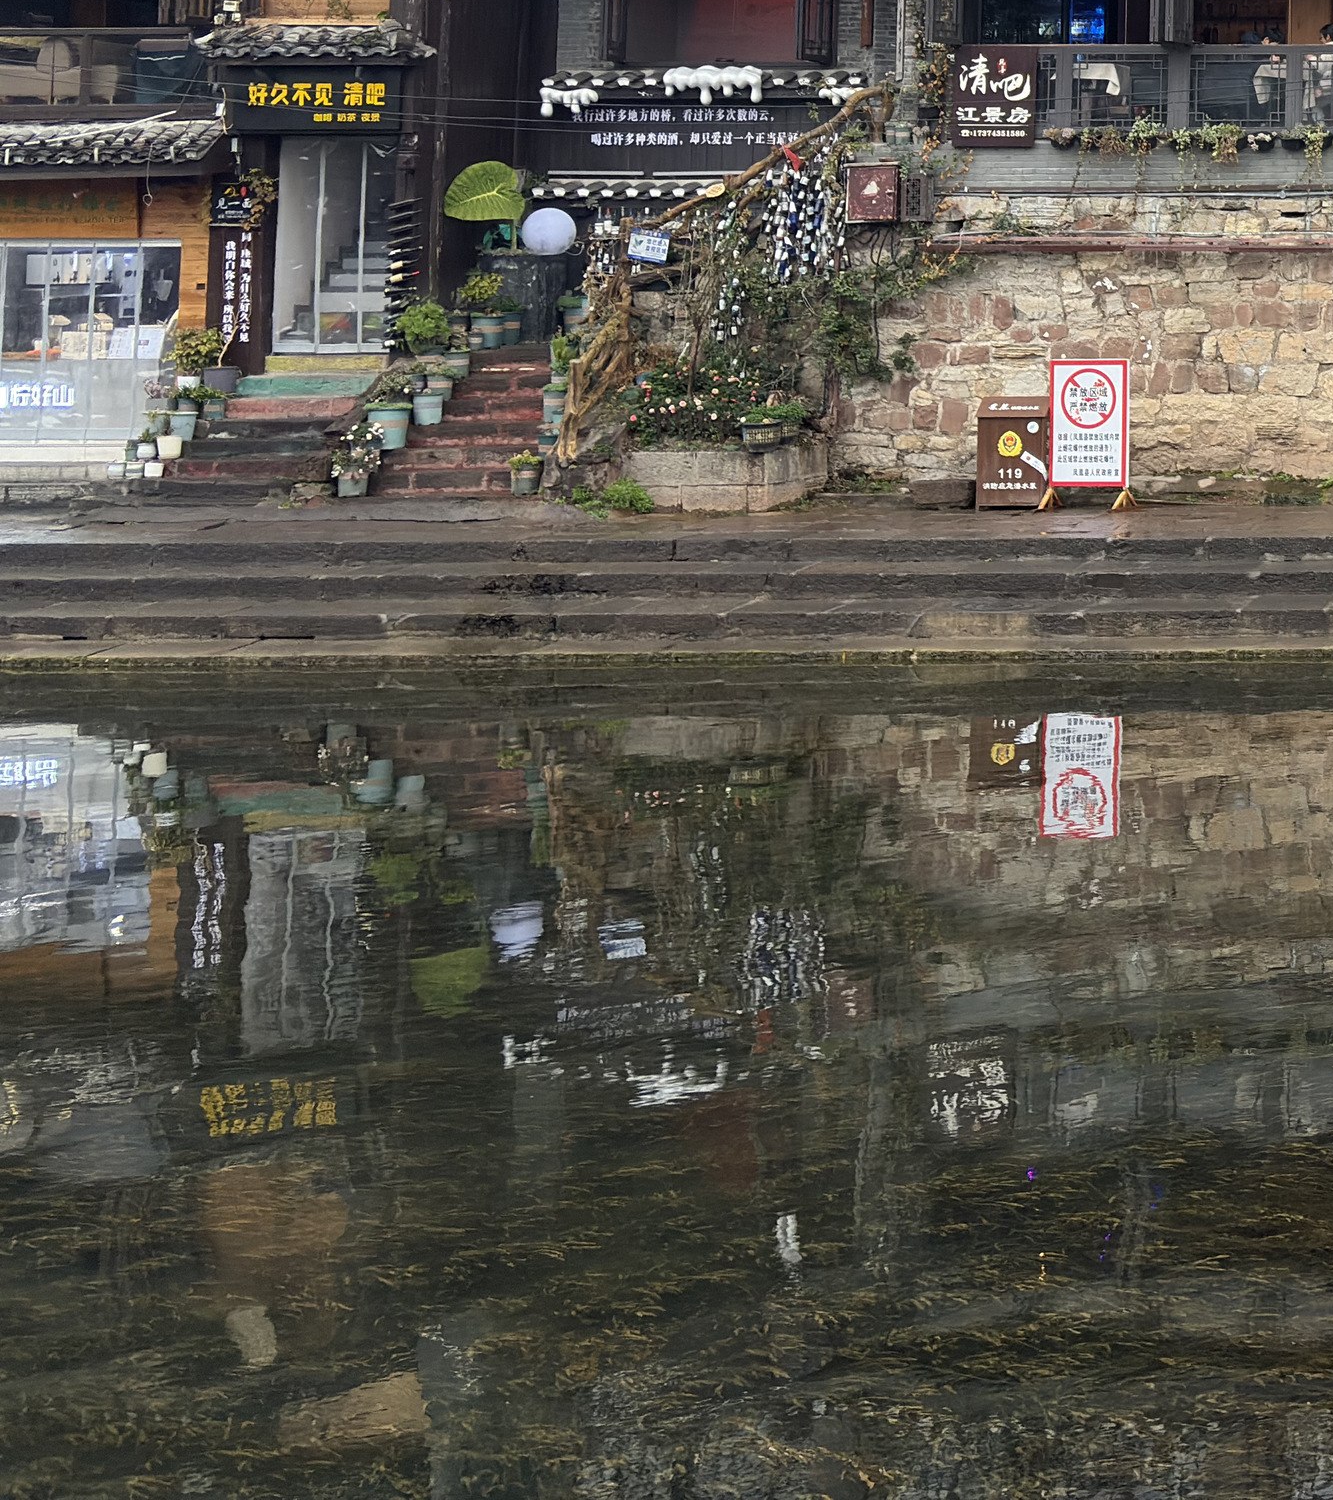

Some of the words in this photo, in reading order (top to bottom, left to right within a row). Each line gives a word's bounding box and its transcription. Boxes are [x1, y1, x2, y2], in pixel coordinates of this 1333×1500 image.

[959, 53, 1031, 102] 清吧
[248, 82, 333, 106] 好久不见
[343, 82, 385, 106] 清吧
[337, 113, 356, 122] 奶茶
[956, 106, 1031, 123] 江景房
[998, 469, 1022, 479] 119
